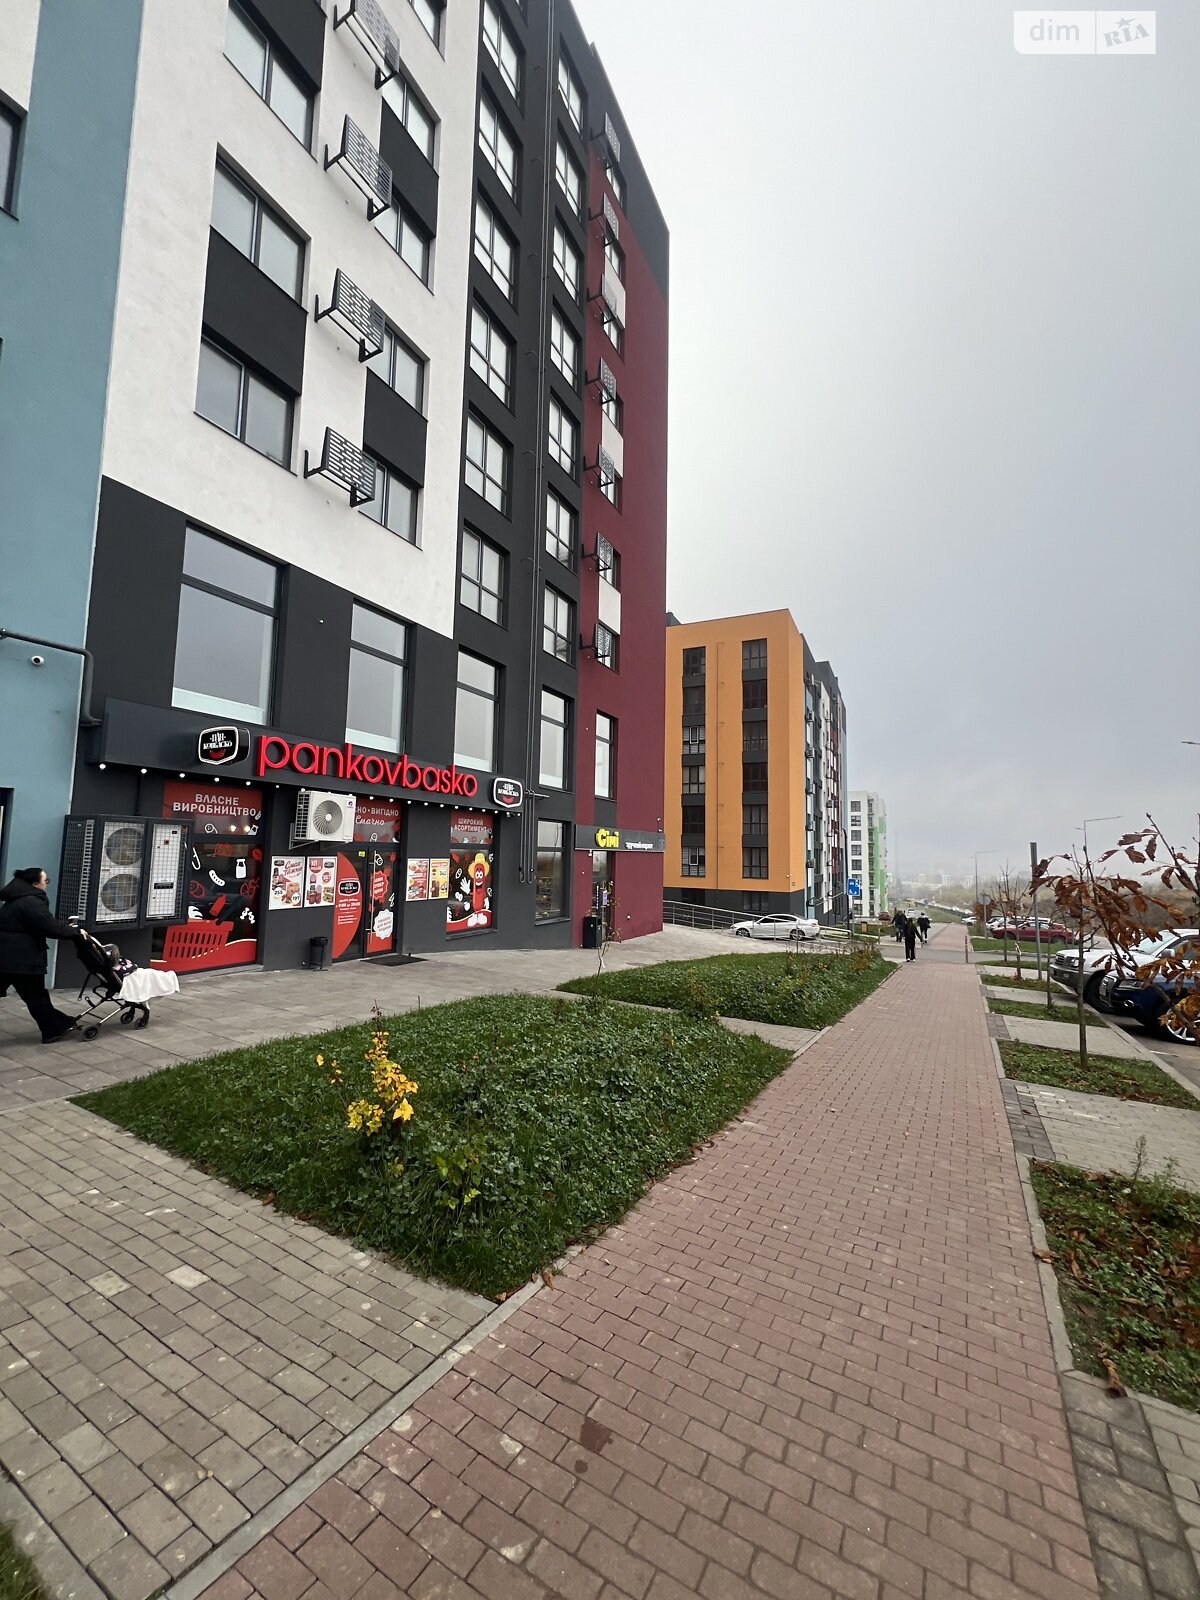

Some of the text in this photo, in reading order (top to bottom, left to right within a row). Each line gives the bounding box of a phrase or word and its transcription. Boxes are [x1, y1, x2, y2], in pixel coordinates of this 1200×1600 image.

[257, 735, 478, 797] pankovbasko
[195, 793, 240, 806] ВЛАСНЕ
[173, 802, 257, 817] ВИРОБНИЦТВО
[371, 807, 399, 817] ВИГІДНО
[458, 818, 484, 826] ШИРОКИЙ
[454, 825, 488, 833] АСОРТИМЕНТ
